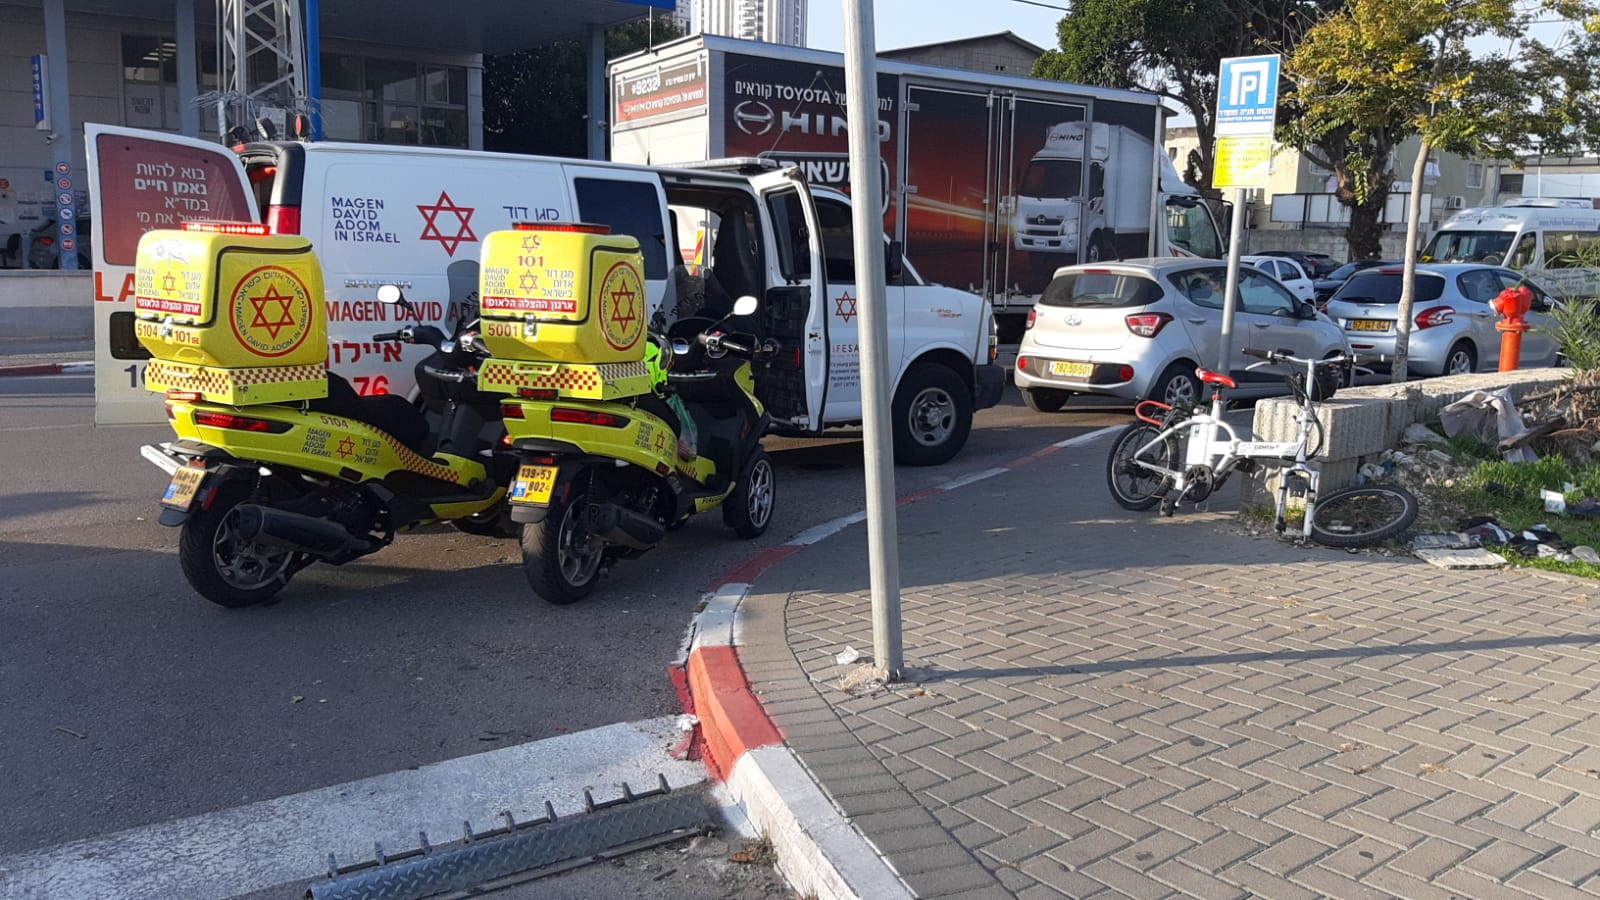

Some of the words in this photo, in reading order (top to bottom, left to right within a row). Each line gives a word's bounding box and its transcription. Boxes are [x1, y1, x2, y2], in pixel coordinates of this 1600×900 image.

[735, 80, 773, 100] קוראים
[775, 85, 832, 105] TOYOTA
[136, 162, 175, 177] להיות
[181, 167, 206, 180] בוא
[134, 177, 167, 191] חיים
[172, 181, 208, 196] נאמן
[331, 196, 385, 210] MAGEN
[136, 211, 150, 224] מי
[155, 212, 174, 226] את
[332, 208, 378, 220] DAVID
[502, 205, 529, 220] דוד
[535, 207, 560, 222] מגן
[334, 220, 381, 231] ADOM
[334, 230, 348, 241] IN
[352, 231, 401, 243] ISRAEL
[517, 255, 545, 268] 101
[485, 267, 509, 275] MAGEN
[485, 298, 516, 308] הלאומי
[518, 299, 547, 309] ההצלה
[550, 301, 574, 311] ארגון
[326, 301, 386, 321] MAGEN
[394, 301, 443, 321] DAVID
[138, 323, 158, 337] 5104
[174, 330, 191, 344] 101
[488, 323, 518, 337] 5001
[353, 375, 390, 397] 76
[320, 415, 349, 428] 5104
